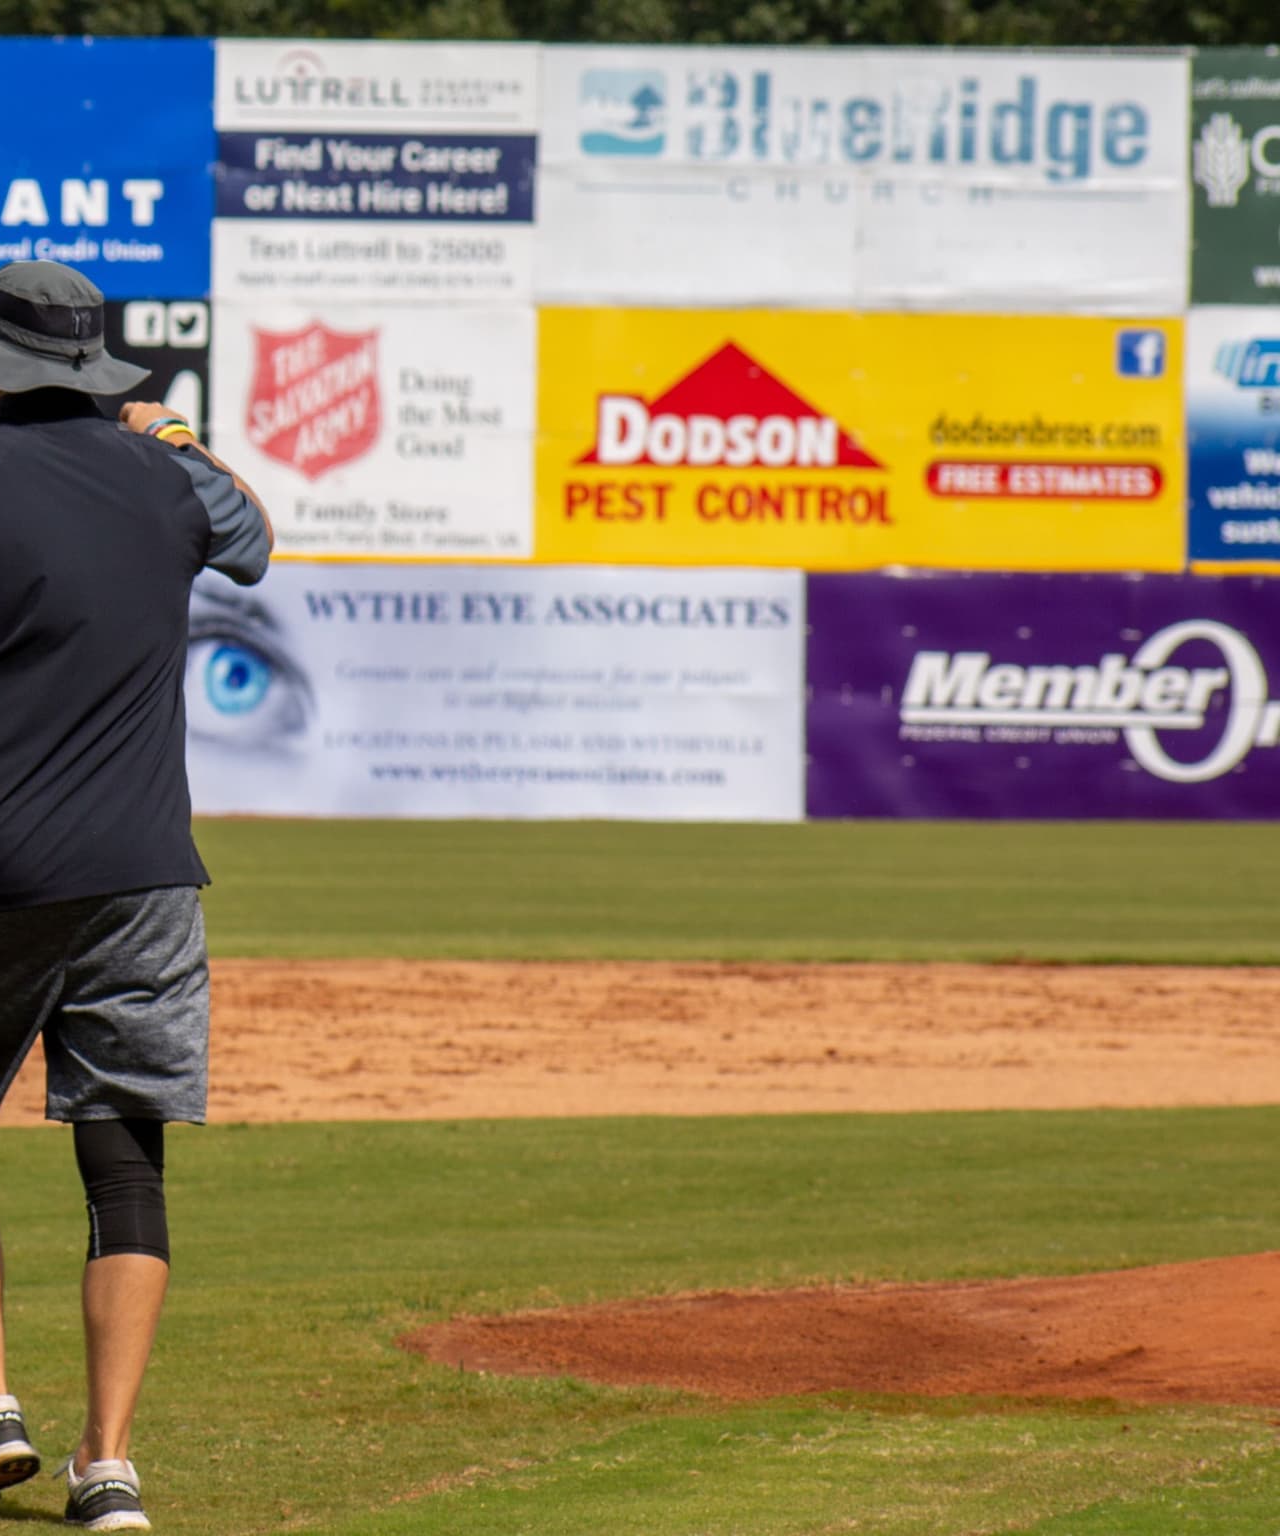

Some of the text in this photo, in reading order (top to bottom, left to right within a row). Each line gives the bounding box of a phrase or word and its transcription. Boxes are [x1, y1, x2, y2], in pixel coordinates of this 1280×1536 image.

[682, 68, 1152, 184] BlueRidge
[255, 138, 502, 174] Find Your Career
[244, 180, 507, 215] or Next Hire Here!
[727, 176, 996, 203] CHURCH
[36, 239, 100, 263] Credit
[103, 238, 164, 262] Union
[398, 370, 473, 399] Doing
[399, 403, 503, 427] the Most
[597, 394, 840, 469] DODSON
[930, 412, 1162, 450] dodsonbros.com
[396, 435, 465, 460] Good
[938, 465, 1154, 498] FREE ESTIMATES
[564, 481, 897, 527] PEST CONTROL
[305, 591, 792, 629] WYTHE EYE ASSOCIATES
[900, 650, 1228, 713] Member
